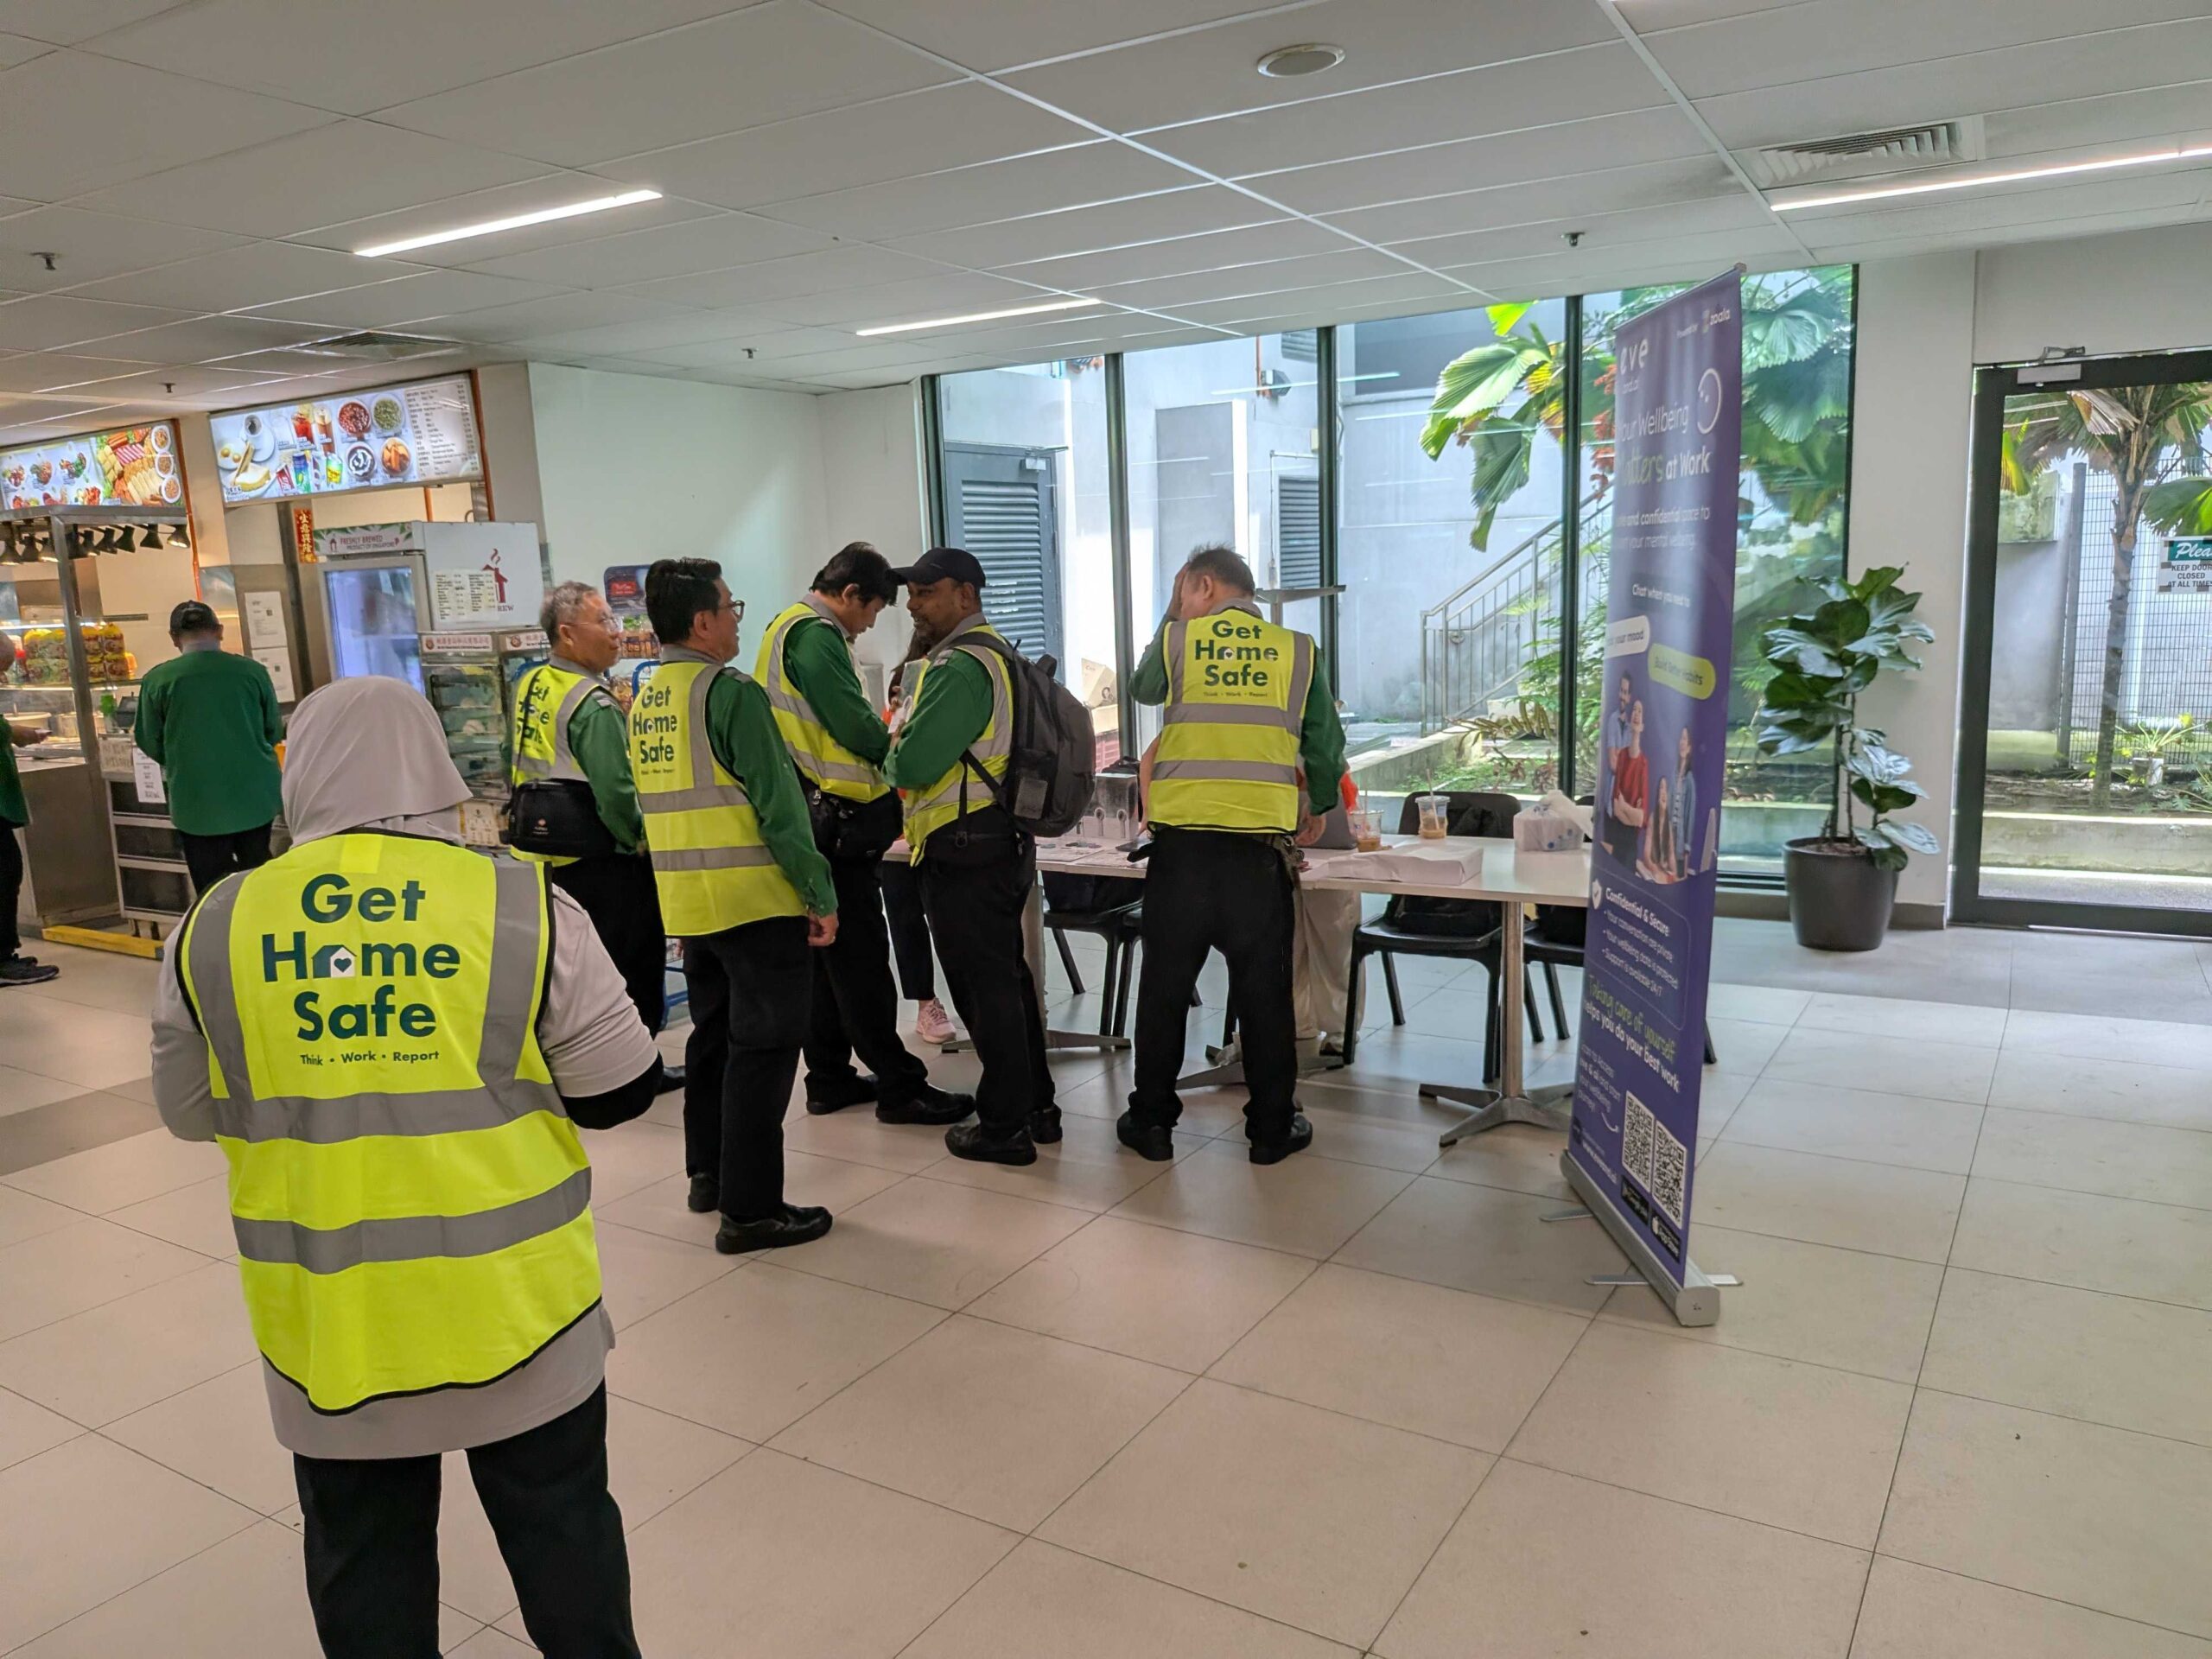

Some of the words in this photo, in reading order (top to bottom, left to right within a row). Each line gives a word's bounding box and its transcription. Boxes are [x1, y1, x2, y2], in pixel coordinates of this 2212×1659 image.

[1620, 338, 1649, 375] eve
[1638, 401, 1689, 435] Wellbeing
[1666, 458, 1677, 480] at
[1679, 446, 1712, 475] Work
[1640, 505, 1682, 526] confidential
[1700, 505, 1710, 520] to
[1211, 620, 1262, 639] Get
[1204, 664, 1268, 687] Safe
[641, 685, 671, 709] Get
[639, 736, 675, 764] Safe
[301, 874, 426, 924] Get
[1605, 887, 1643, 914] Confidential
[1643, 909, 1649, 923] &
[1649, 912, 1671, 938] Secure
[294, 984, 437, 1042] Safe
[1633, 1009, 1643, 1034] of
[300, 1053, 324, 1066] Think
[340, 1050, 377, 1064] Work
[392, 1051, 440, 1064] Report
[1600, 1014, 1615, 1035] you
[1615, 1019, 1626, 1044] do
[1625, 1031, 1643, 1056] your
[1643, 1046, 1661, 1075] best
[1661, 1062, 1681, 1094] work
